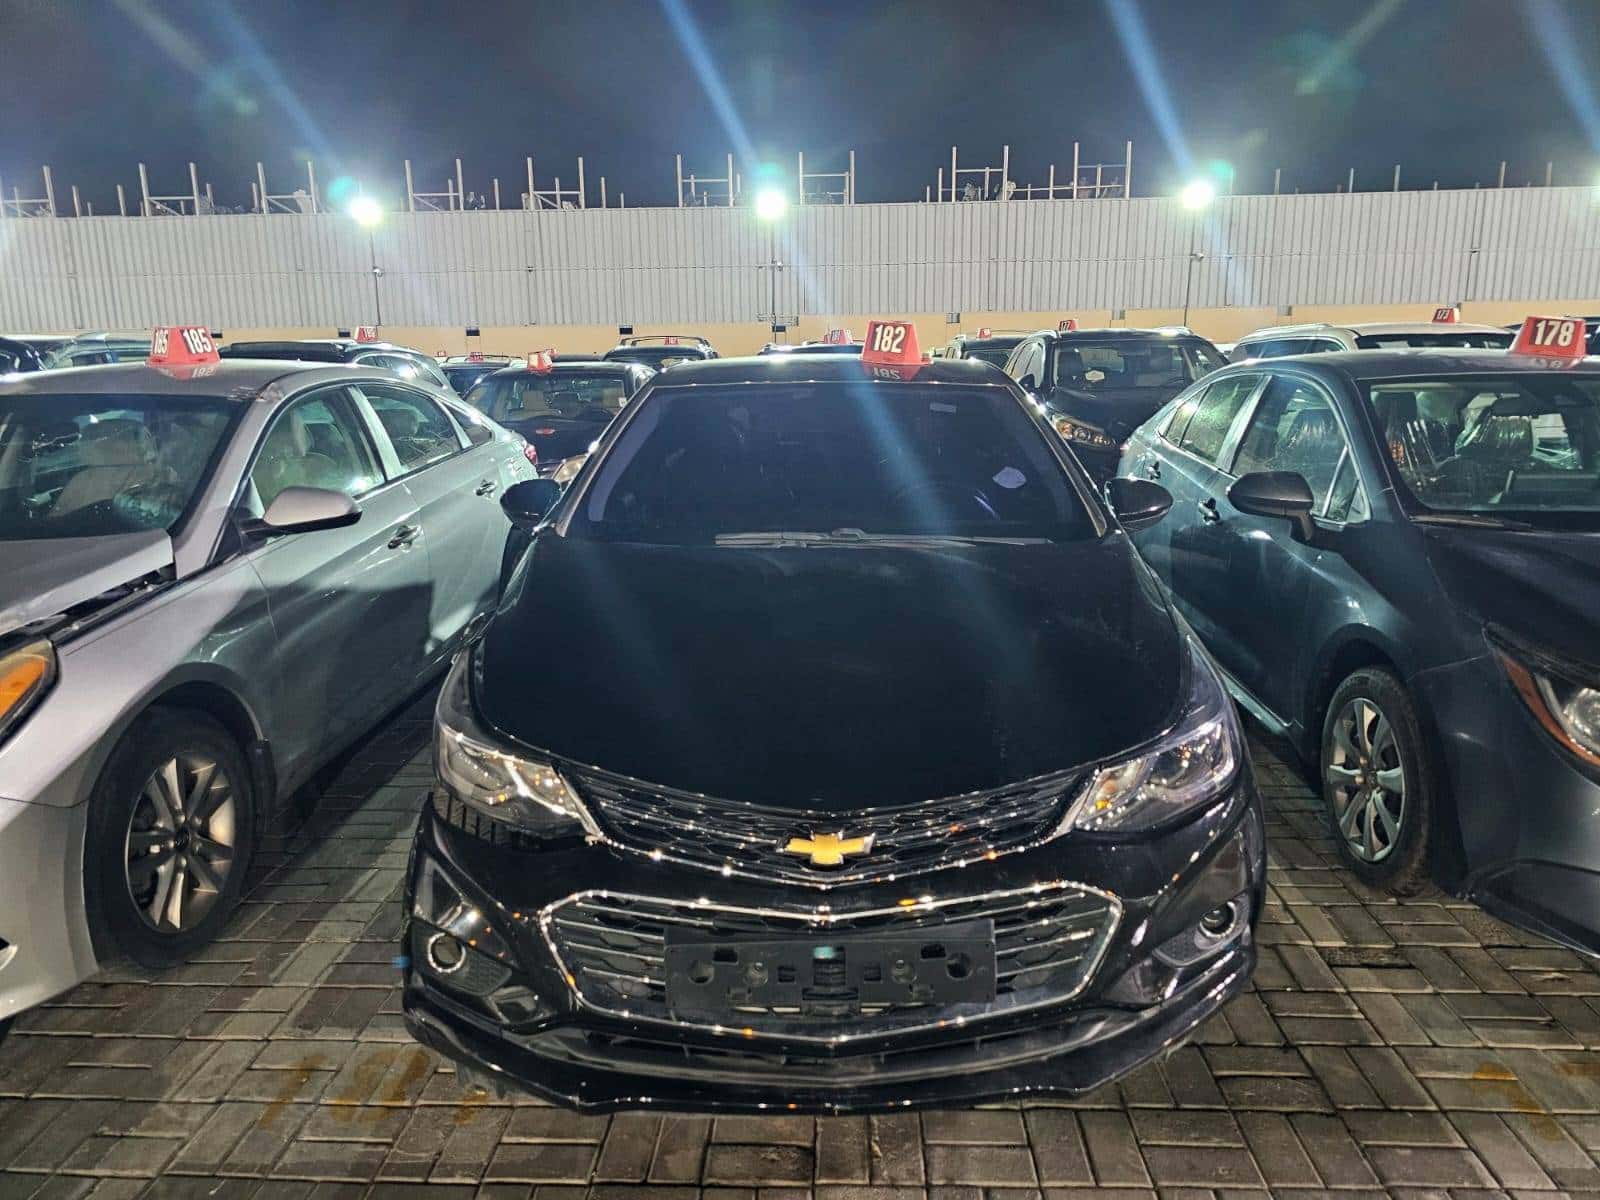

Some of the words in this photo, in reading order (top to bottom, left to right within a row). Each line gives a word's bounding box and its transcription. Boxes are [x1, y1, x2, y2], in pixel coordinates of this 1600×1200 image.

[182, 328, 212, 354] 185
[873, 324, 905, 353] 182
[1534, 319, 1575, 347] 178
